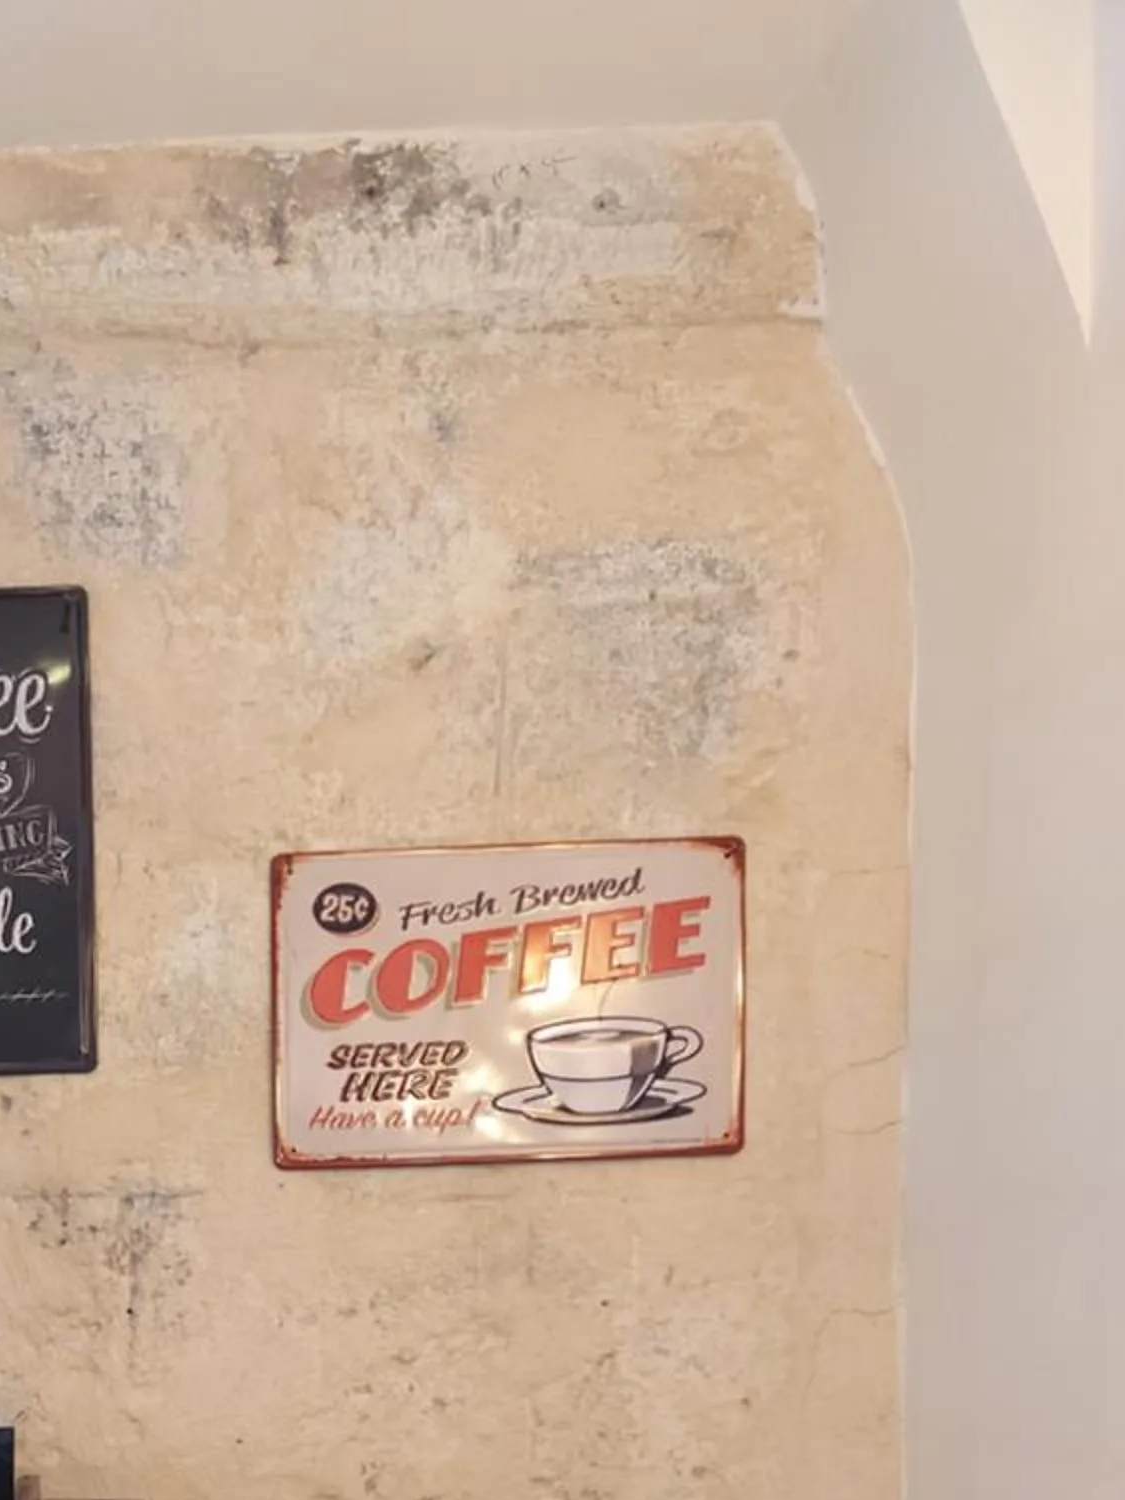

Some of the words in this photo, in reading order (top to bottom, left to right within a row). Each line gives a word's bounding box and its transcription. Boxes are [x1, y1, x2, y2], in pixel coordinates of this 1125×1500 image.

[319, 890, 370, 925] 25¢
[398, 891, 499, 932] Fresh
[510, 867, 645, 917] Brewed
[305, 896, 711, 1026] COFFEE
[326, 1040, 470, 1072] SERVED
[339, 1068, 460, 1103] HERE
[308, 1105, 377, 1132] Have
[384, 1112, 407, 1131] a
[413, 1099, 482, 1139] cup!
